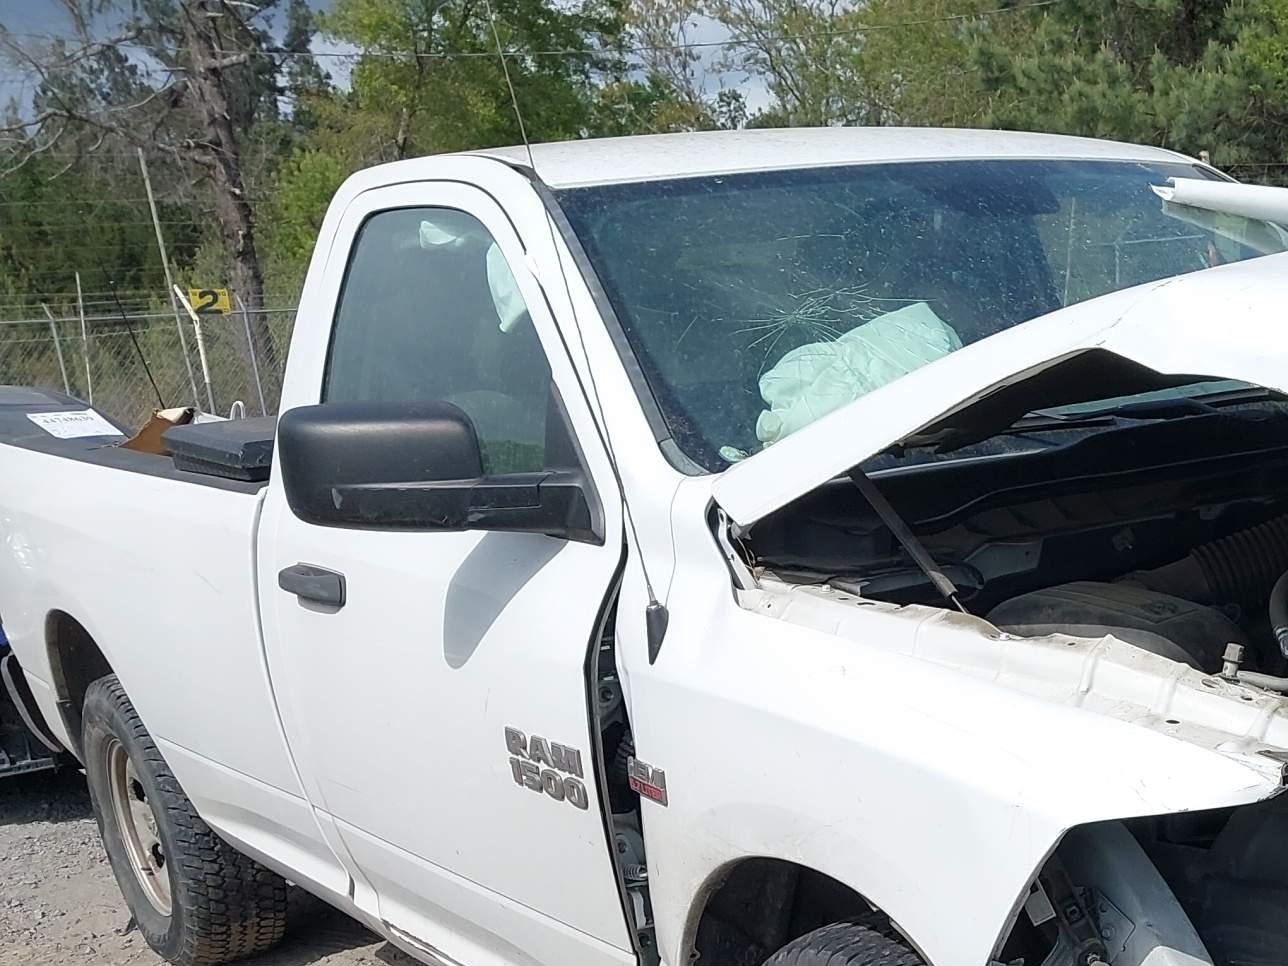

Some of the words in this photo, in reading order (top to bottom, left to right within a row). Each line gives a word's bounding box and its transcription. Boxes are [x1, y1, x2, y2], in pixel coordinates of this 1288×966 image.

[195, 290, 223, 314] 2
[504, 725, 585, 779] RAM
[509, 756, 590, 811] 1500
